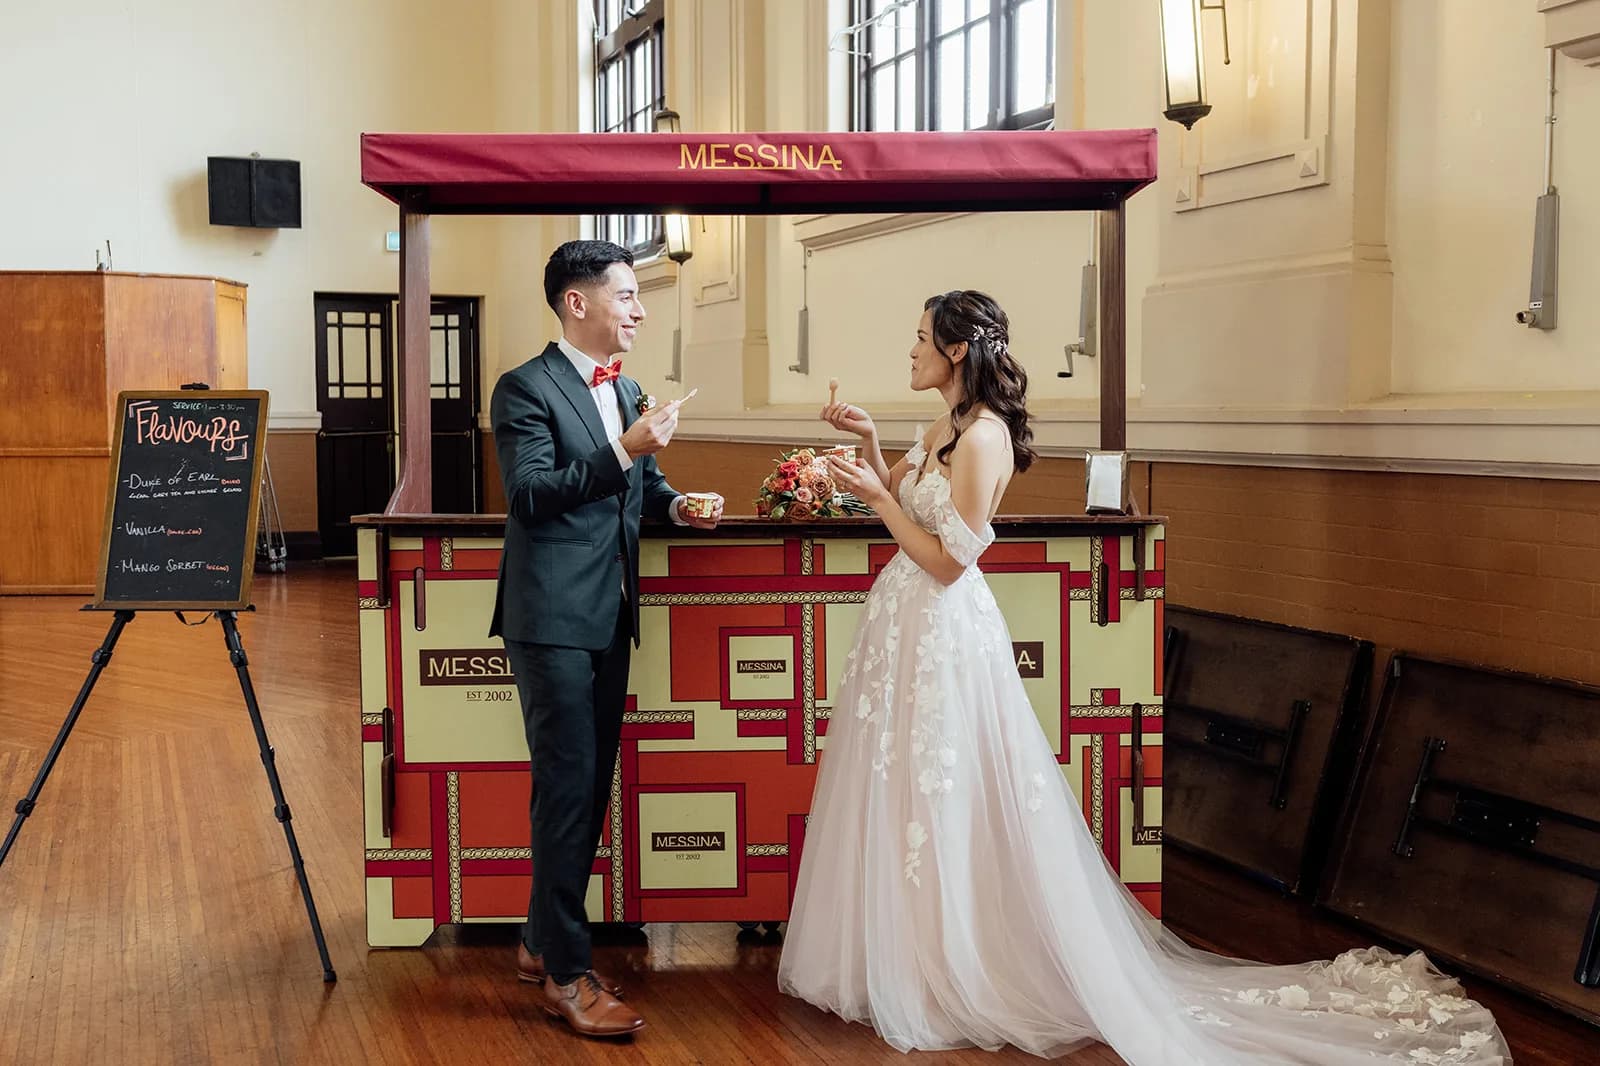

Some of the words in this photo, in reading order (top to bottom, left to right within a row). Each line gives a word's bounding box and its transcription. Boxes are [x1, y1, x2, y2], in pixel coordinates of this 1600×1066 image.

[678, 143, 842, 171] MESSINA
[166, 558, 206, 572] SORBET
[739, 662, 784, 671] MESSINA
[466, 691, 482, 701] EST
[484, 690, 513, 702] 2002
[656, 835, 721, 848] MESSINA
